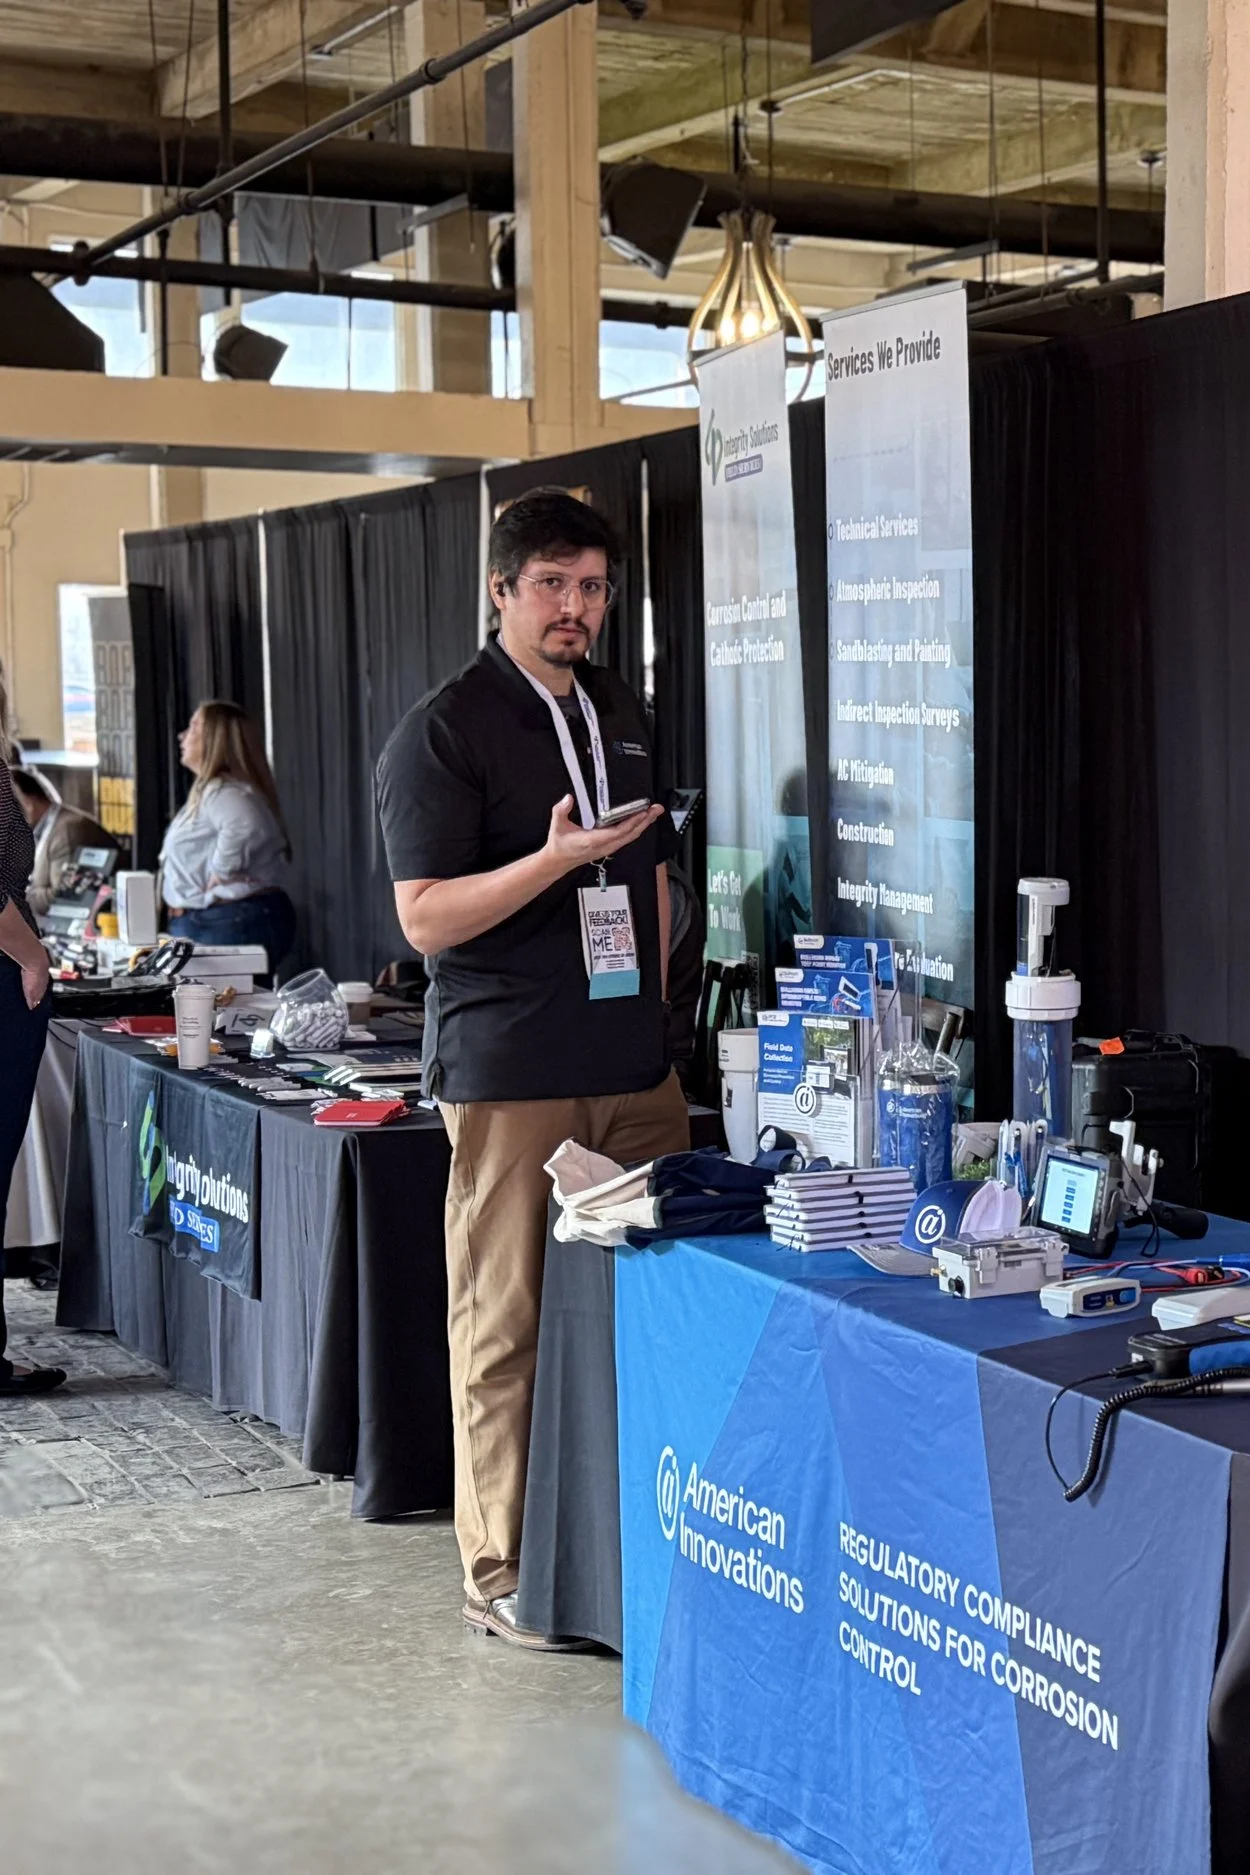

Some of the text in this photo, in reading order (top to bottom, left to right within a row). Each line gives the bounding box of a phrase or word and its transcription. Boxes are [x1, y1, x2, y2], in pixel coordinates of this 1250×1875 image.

[828, 330, 941, 381] Services We Provide
[836, 514, 918, 541] Technical Services
[742, 593, 770, 622] Control
[771, 590, 786, 618] and
[836, 574, 940, 606] Atmospheric Inspection
[743, 636, 784, 663] Protection
[837, 639, 951, 668] Sandblasting and Painting
[837, 699, 960, 732] Indirect Inspection Surveys
[837, 759, 894, 789] AC Mitigation
[837, 819, 894, 847] Construction
[837, 877, 933, 915] Integrity Management
[709, 904, 719, 928] To
[592, 936, 613, 952] ME
[201, 1167, 248, 1224] olutions
[683, 1462, 786, 1549] American
[680, 1511, 804, 1614] Innovations
[839, 1521, 1101, 1683] REGULATORY COMPLIANCE
[839, 1621, 922, 1696] CONTROL
[839, 1573, 1118, 1751] SOLUTIONS FOR CORROSION
